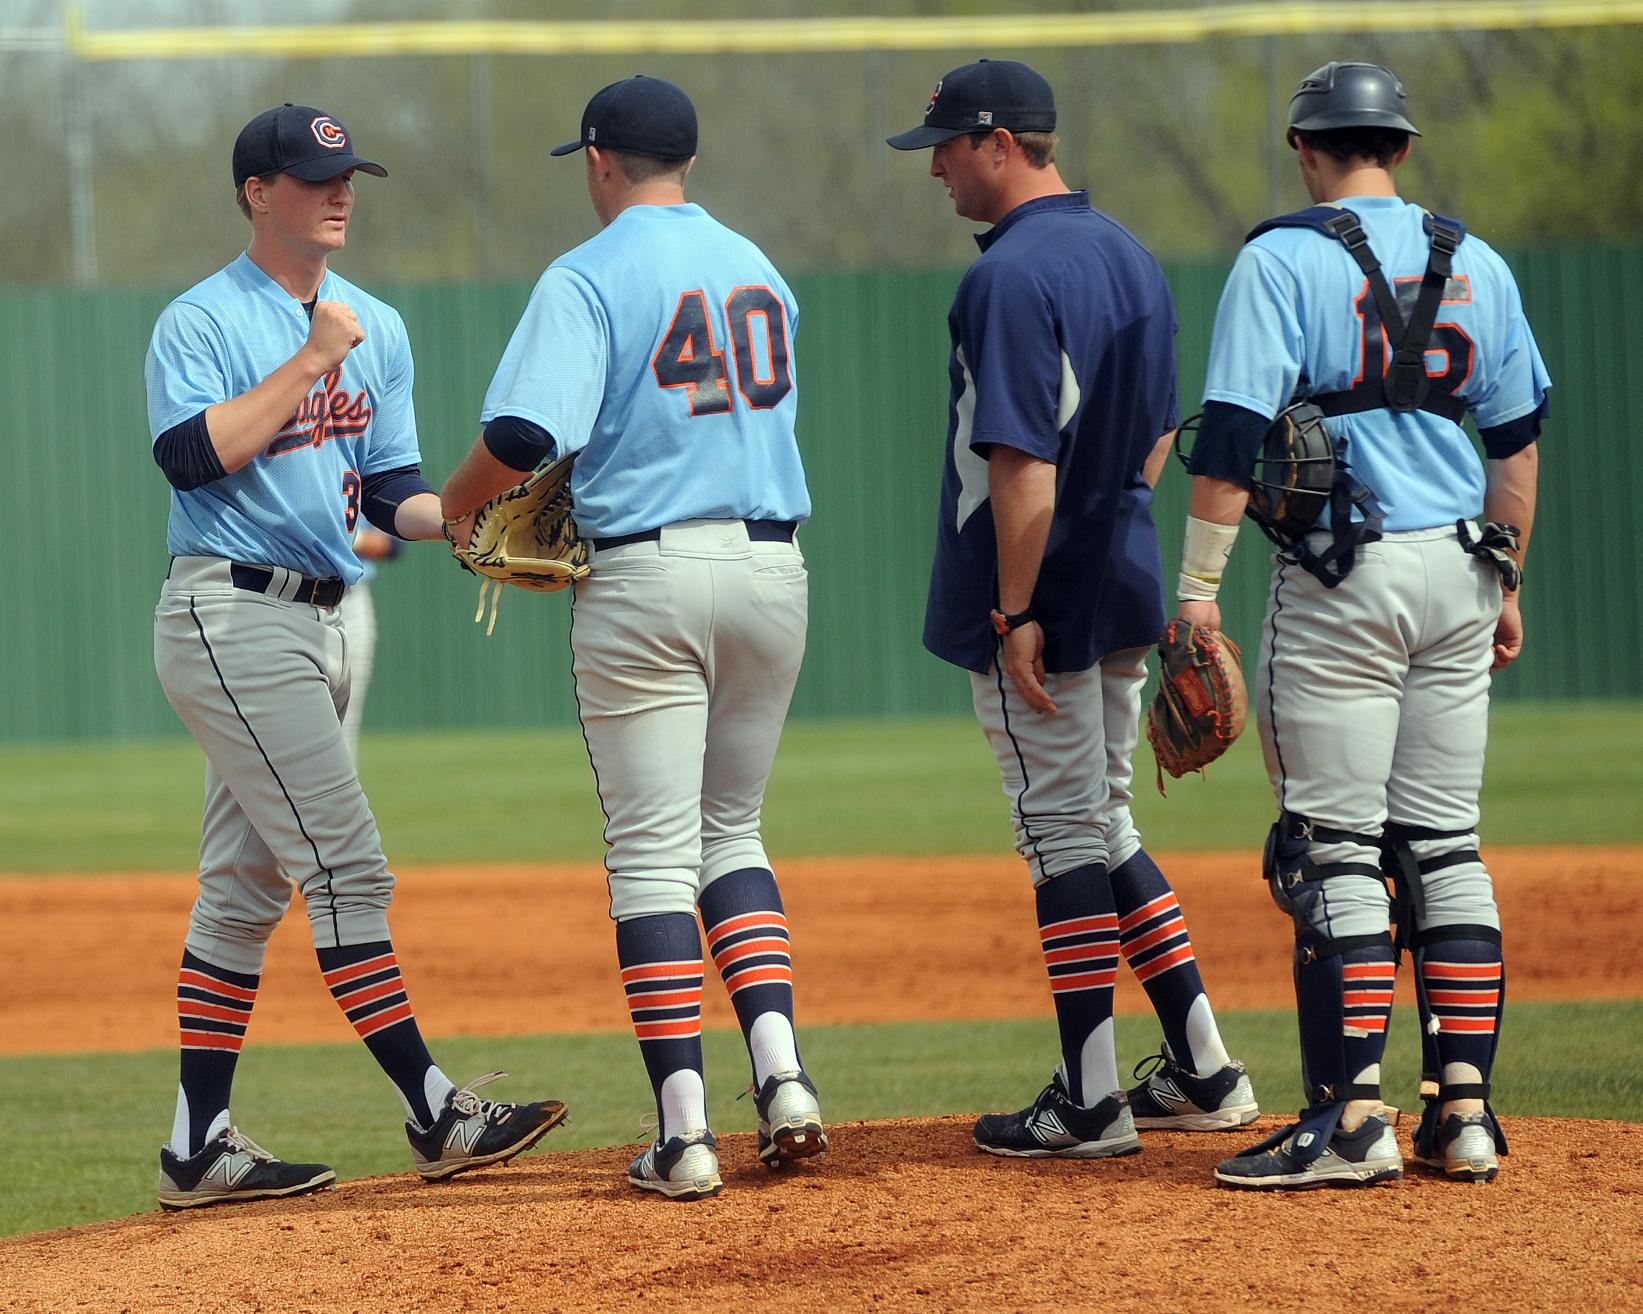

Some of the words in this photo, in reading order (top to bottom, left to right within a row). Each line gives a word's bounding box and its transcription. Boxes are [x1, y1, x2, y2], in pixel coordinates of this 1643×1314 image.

[651, 285, 792, 416] 40
[1351, 274, 1475, 398] 15
[1148, 1077, 1188, 1112] N
[442, 1119, 488, 1156] N
[1029, 1109, 1070, 1145] N
[202, 1152, 256, 1189] N
